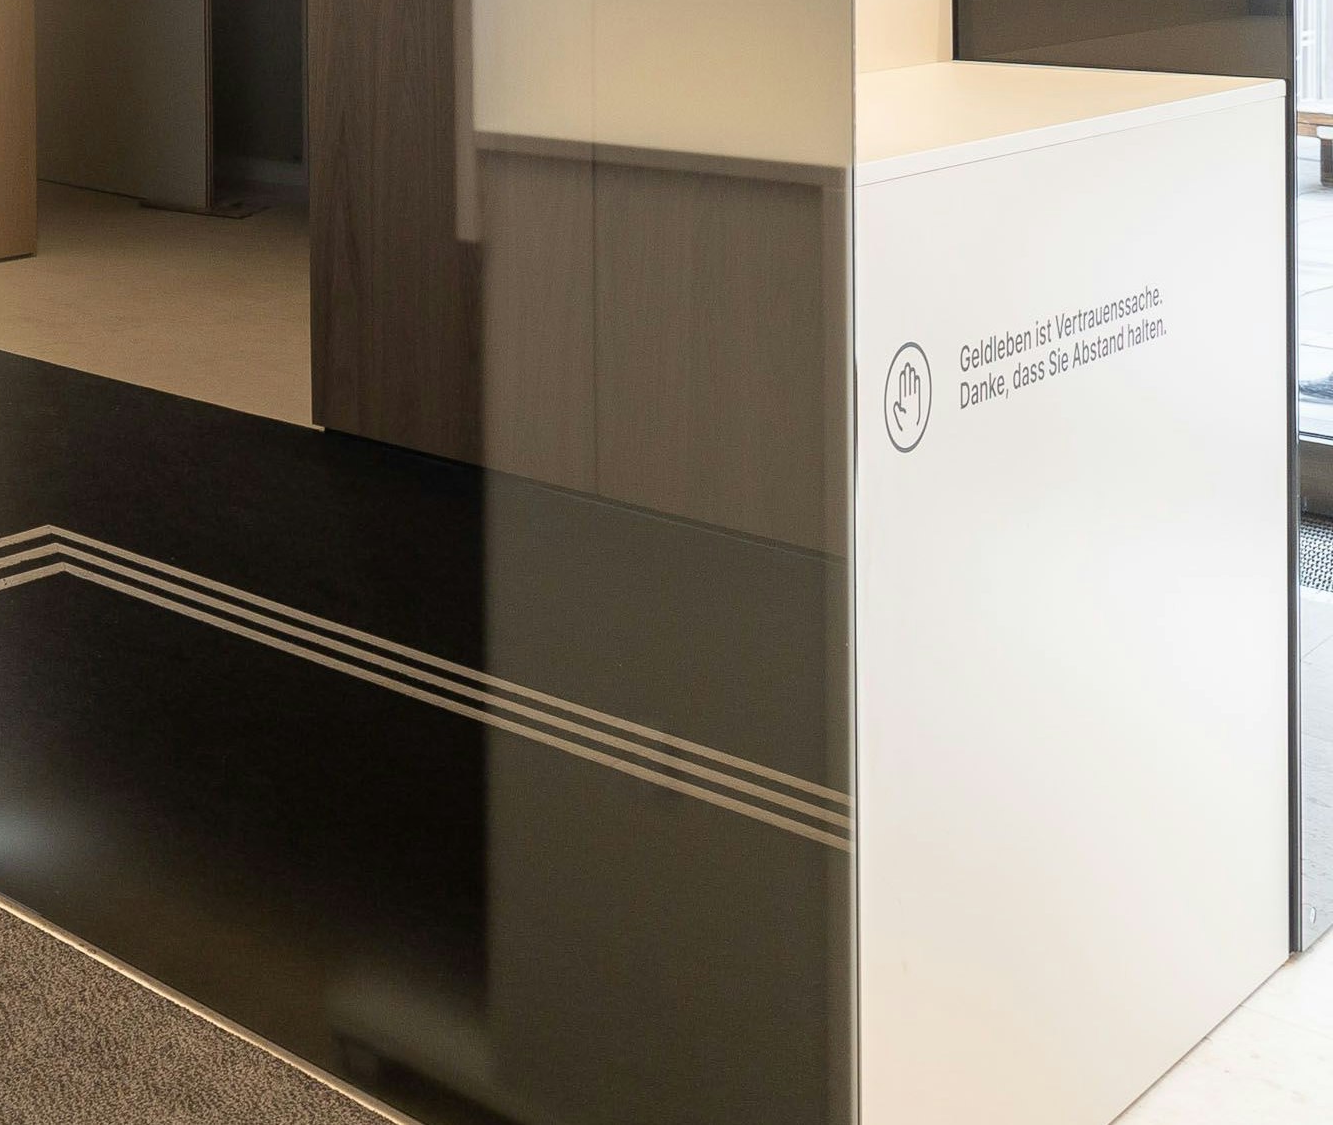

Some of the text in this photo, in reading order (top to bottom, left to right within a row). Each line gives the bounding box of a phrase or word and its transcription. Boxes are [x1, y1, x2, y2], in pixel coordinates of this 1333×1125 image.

[960, 286, 1163, 372] Geldleben ist Vertrauenssache.
[960, 318, 1167, 409] Danke, dass Sie Abstand halten.
